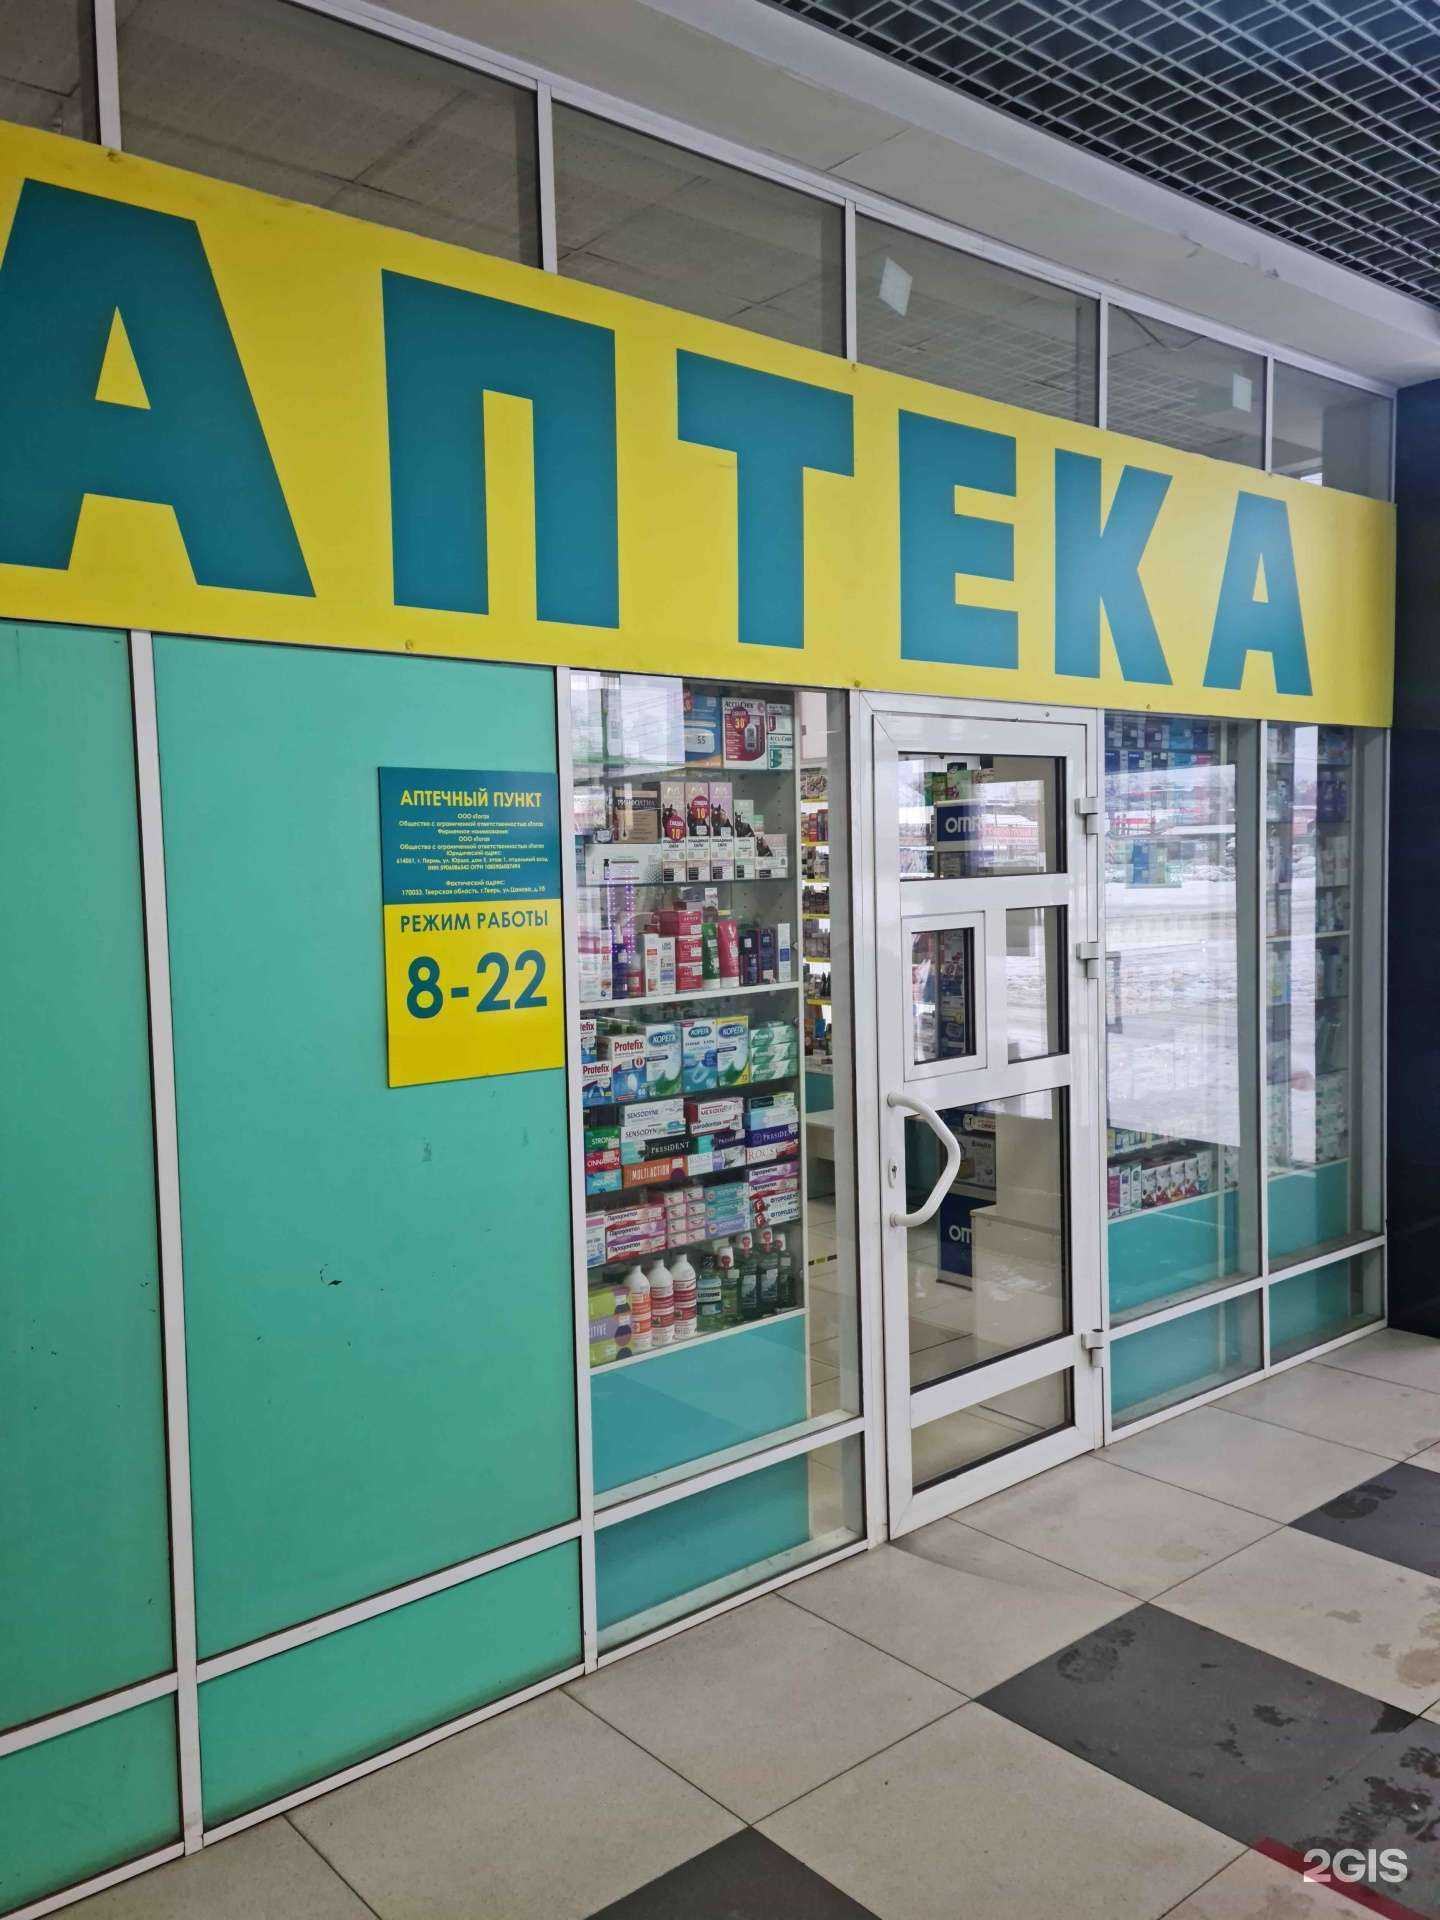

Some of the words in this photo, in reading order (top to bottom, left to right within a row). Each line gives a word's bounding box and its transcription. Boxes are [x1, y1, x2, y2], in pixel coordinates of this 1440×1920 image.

[0, 178, 1313, 697] АПТЕКА
[400, 788, 488, 807] АПТЕЧНЫЙ
[494, 792, 542, 807] ПУНКТ
[400, 913, 471, 933] РЕЖИМ
[477, 910, 548, 929] РАБОТЫ
[406, 949, 548, 1019] 8-22
[614, 1039, 643, 1052] Protefix
[582, 1063, 609, 1074] Protefix
[626, 1109, 658, 1119] SENSODYNE
[625, 1128, 657, 1137] SENSODYN
[651, 1141, 690, 1153] PRESIDENT
